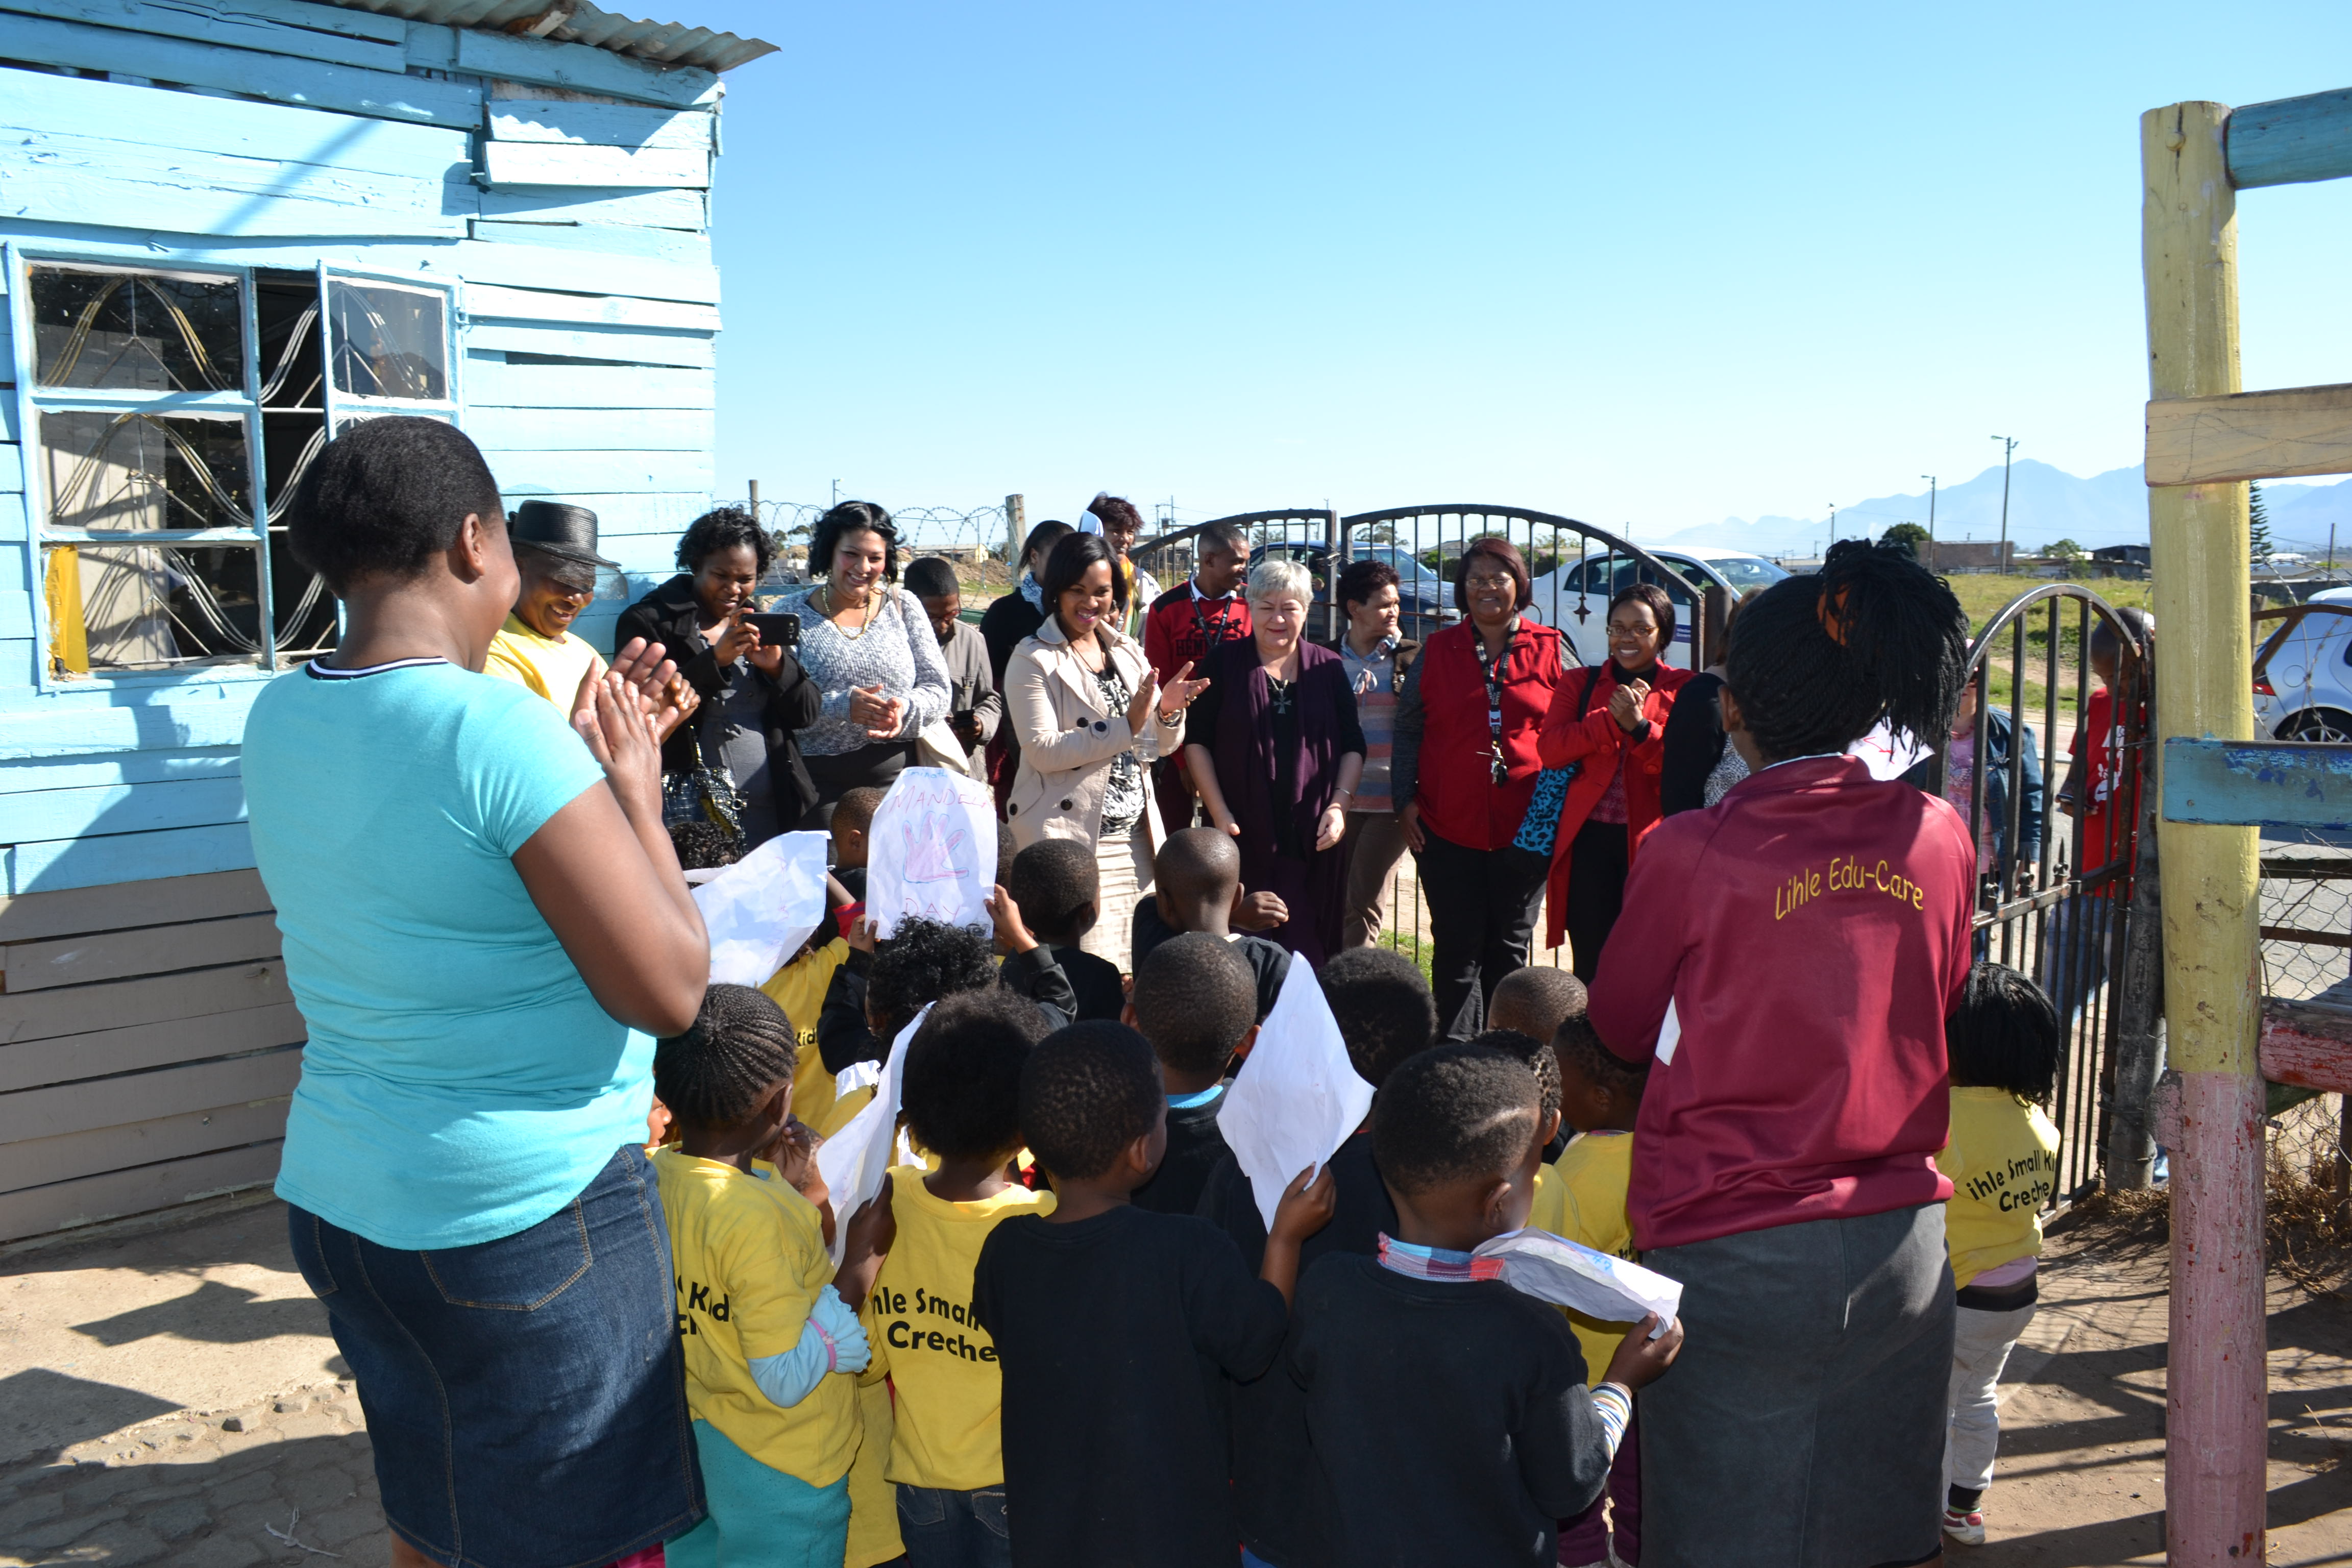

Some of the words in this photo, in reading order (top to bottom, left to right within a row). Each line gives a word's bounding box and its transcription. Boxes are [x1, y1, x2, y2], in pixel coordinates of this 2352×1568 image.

[889, 785, 994, 814] MANDELA
[1775, 868, 1821, 920] Lihle
[1829, 855, 1923, 910] Edu-Care
[904, 897, 961, 922] DAY
[1966, 1170, 2005, 1200] ihle
[2007, 1149, 2041, 1181] Small
[1999, 1180, 2049, 1212] Creche
[887, 1320, 997, 1362] Creche
